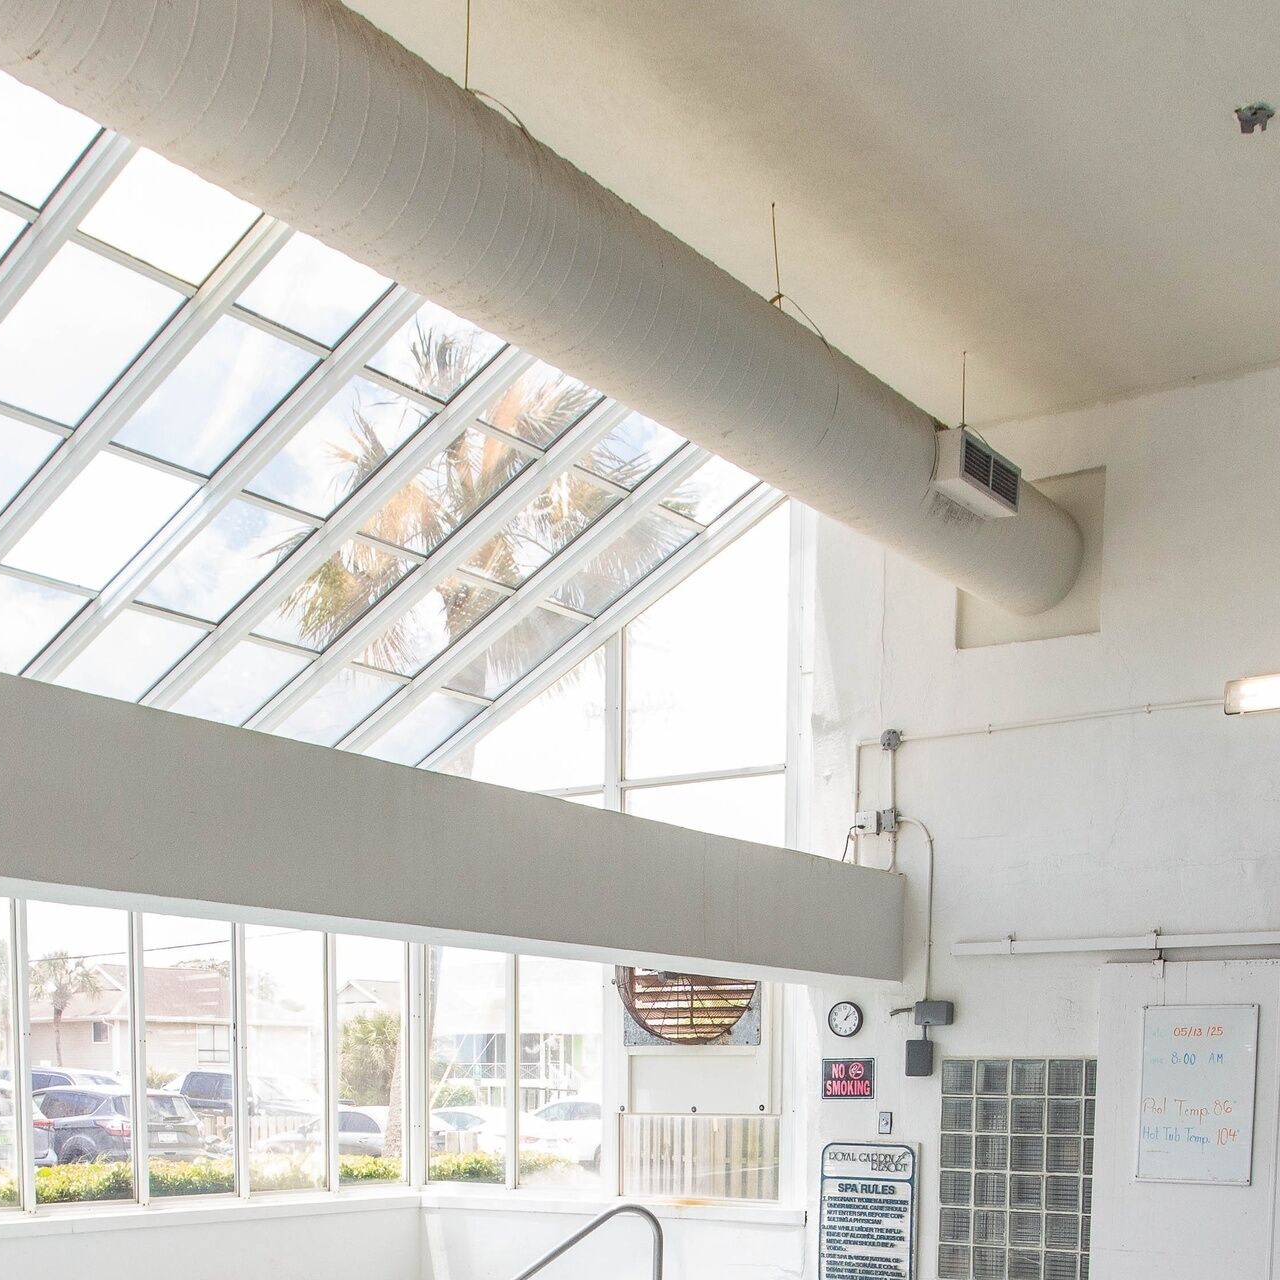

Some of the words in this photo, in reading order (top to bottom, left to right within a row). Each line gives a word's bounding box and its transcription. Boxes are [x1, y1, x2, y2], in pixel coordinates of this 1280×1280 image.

[1171, 1051, 1196, 1065] 8:00
[1208, 1052, 1224, 1064] AM
[831, 1063, 845, 1078] NO
[826, 1080, 870, 1095] SMOKING
[1143, 1096, 1167, 1114] Pool
[1142, 1126, 1160, 1141] Hot
[1162, 1127, 1181, 1142] Tub
[828, 1151, 856, 1162] ROYAL
[858, 1152, 894, 1164] GARDEN
[870, 1161, 908, 1172] RESORT
[838, 1183, 858, 1193] SPA
[860, 1184, 896, 1195] RULES
